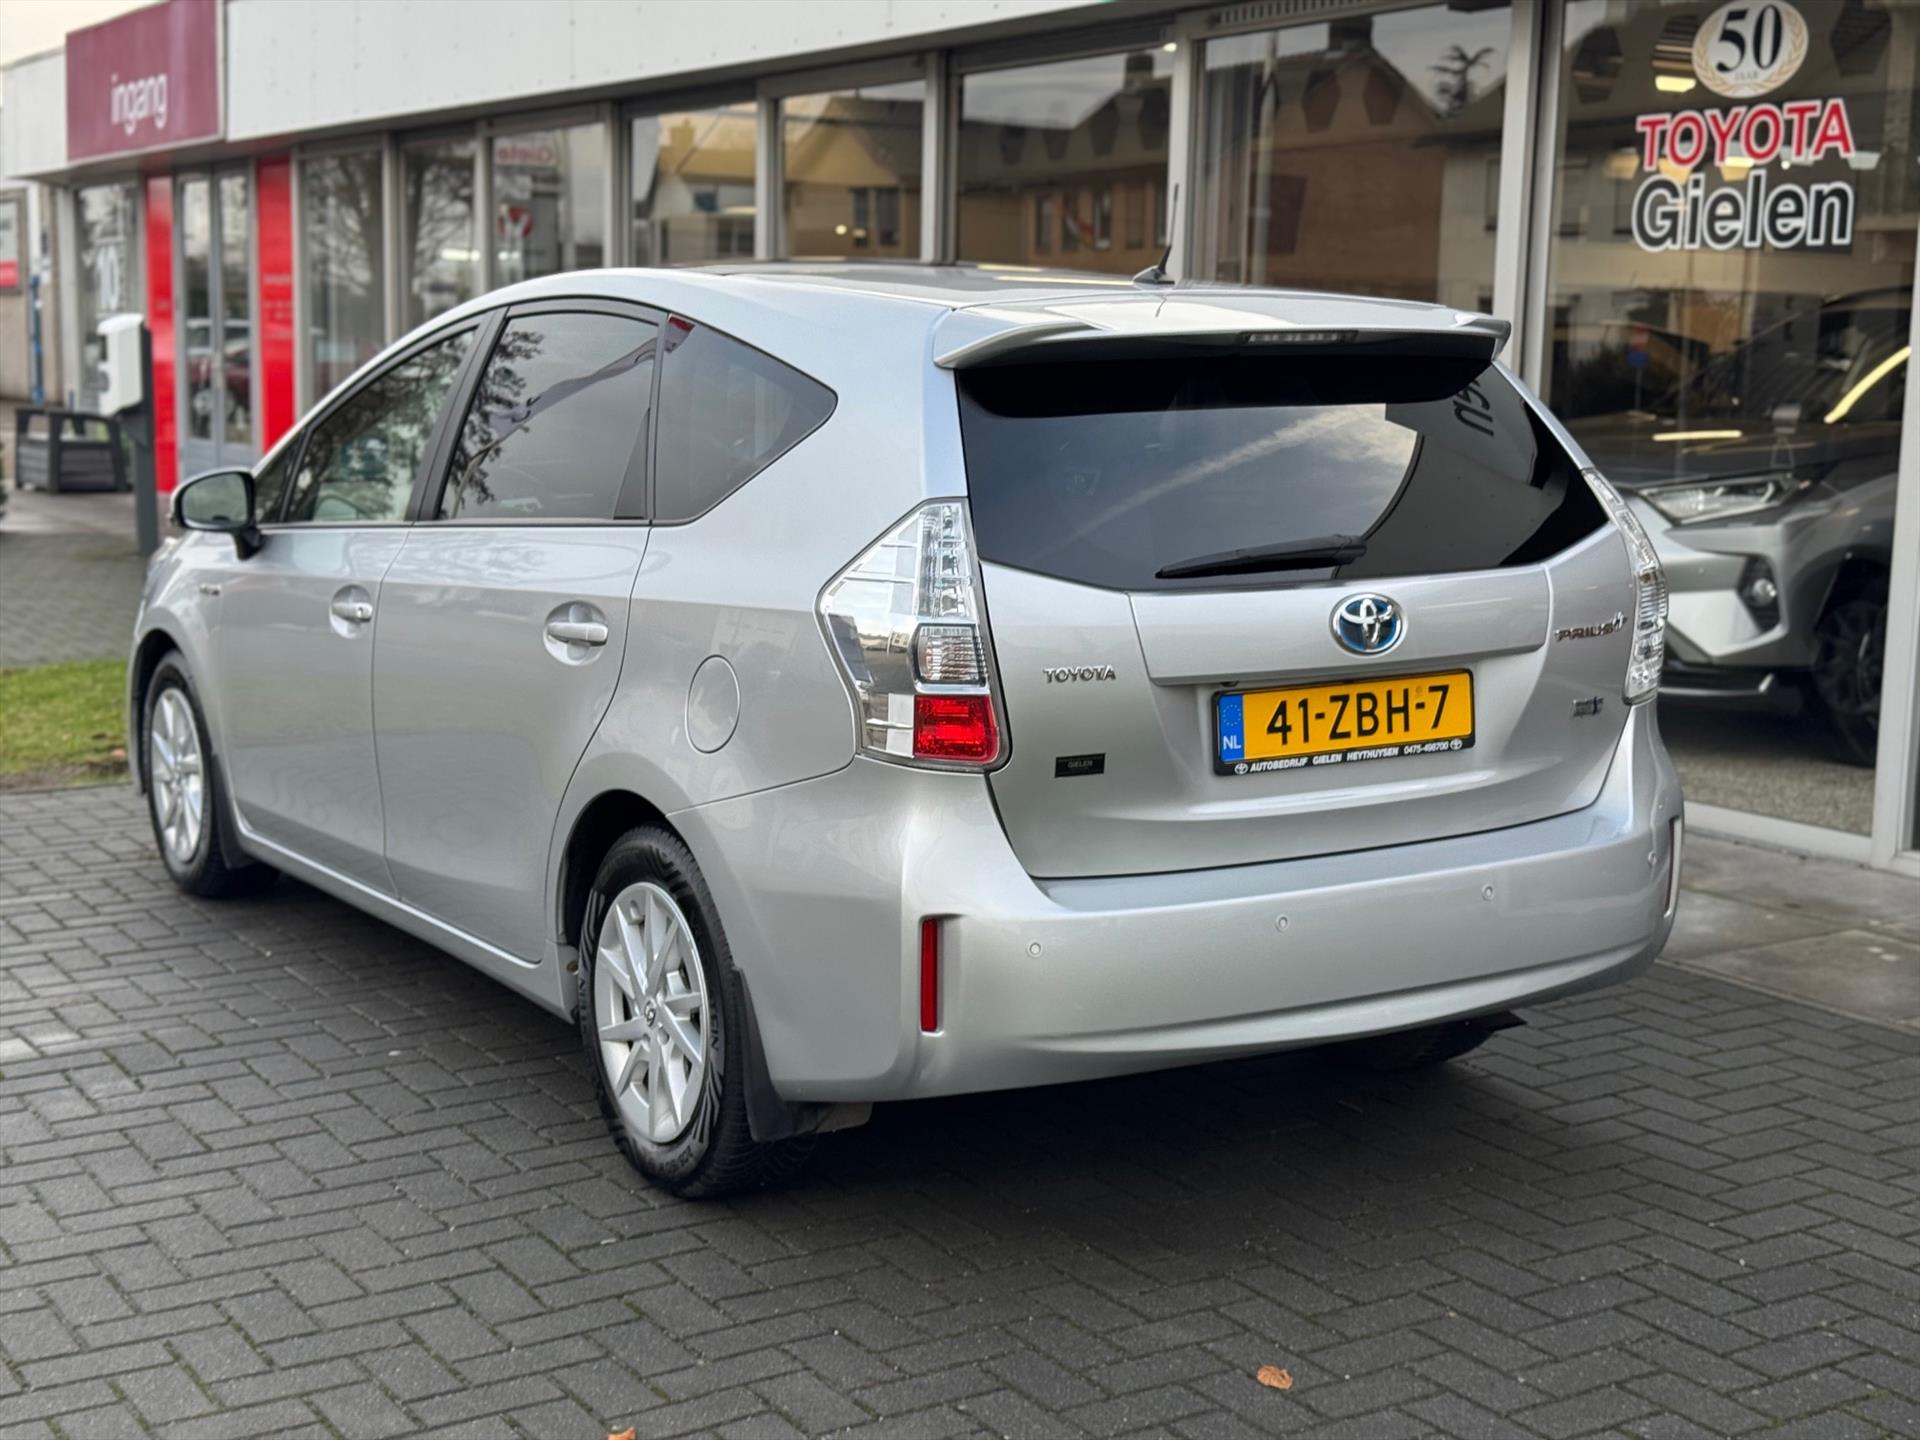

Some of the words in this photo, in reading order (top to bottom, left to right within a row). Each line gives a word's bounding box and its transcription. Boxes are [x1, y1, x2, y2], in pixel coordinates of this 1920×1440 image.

[1716, 4, 1783, 73] 50
[110, 72, 168, 137] ingang
[1636, 97, 1855, 172] TOYOTA
[1631, 169, 1854, 253] Gielen
[1043, 664, 1116, 684] TOYOTA
[1223, 735, 1242, 751] NL
[1266, 684, 1450, 746] 41-ZBH-7
[1250, 756, 1308, 773] AUTOBEDRIJF
[1312, 753, 1342, 765] GIELEN
[1346, 746, 1400, 762] HEYTHUYSEN
